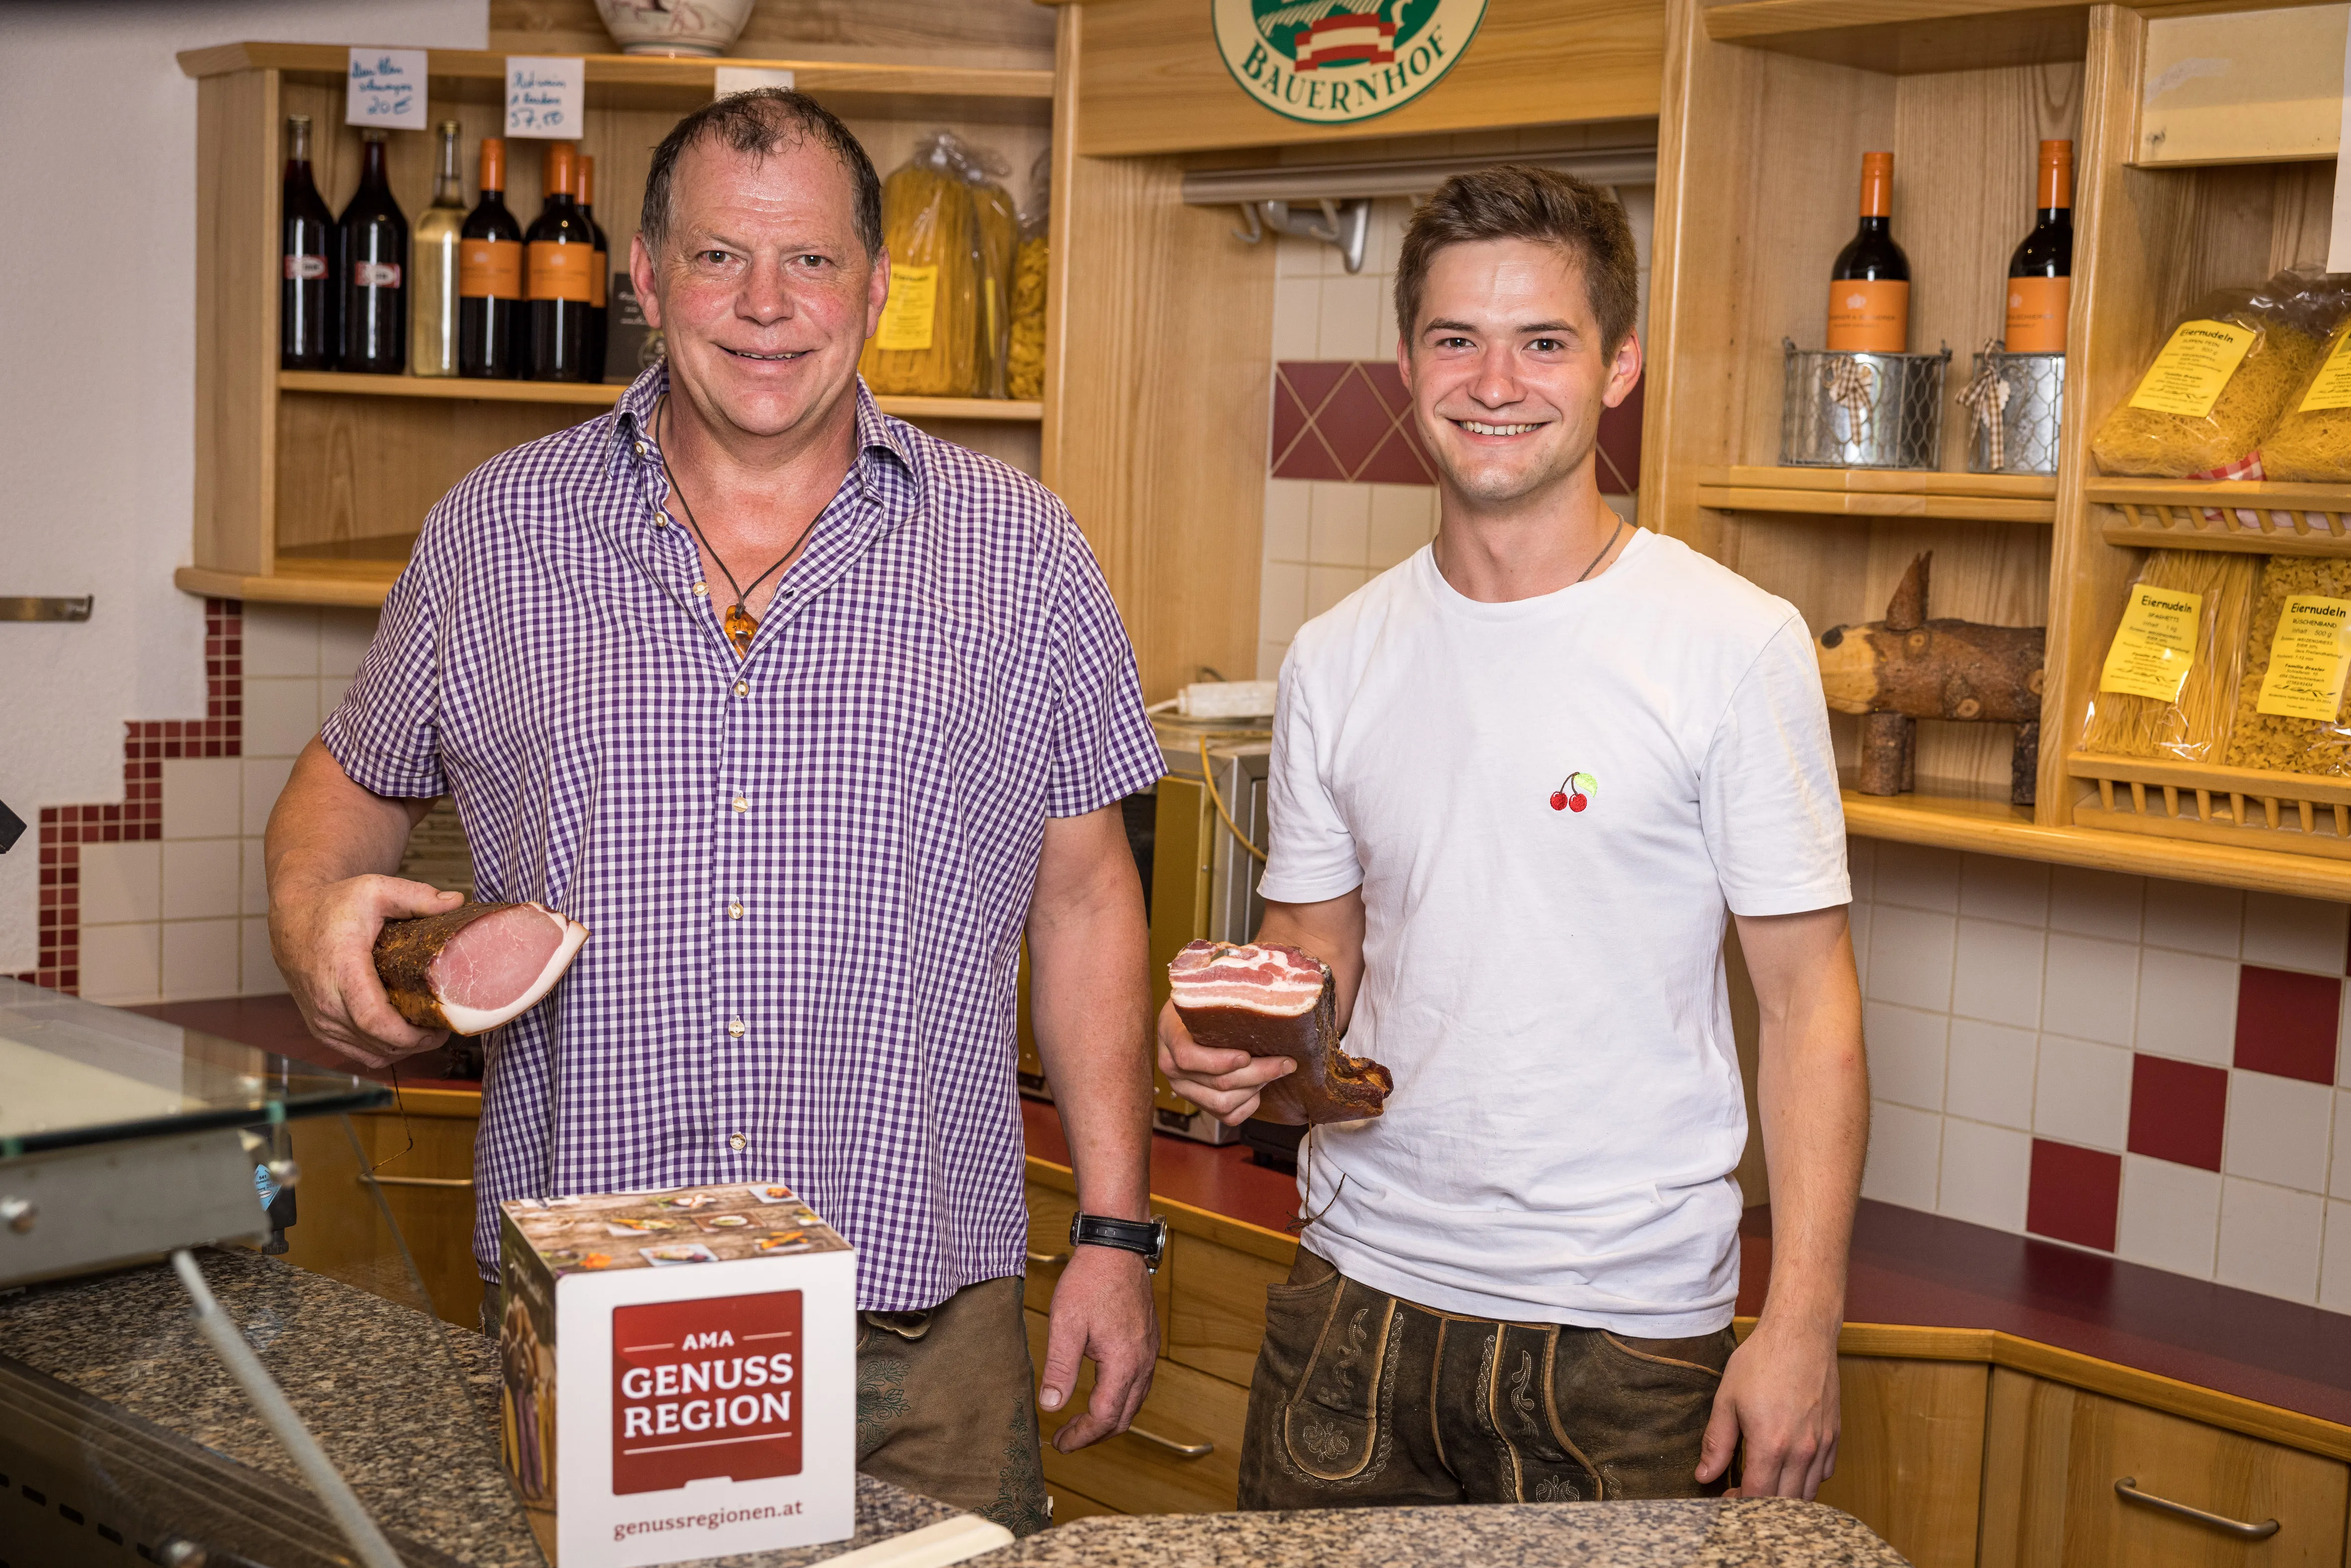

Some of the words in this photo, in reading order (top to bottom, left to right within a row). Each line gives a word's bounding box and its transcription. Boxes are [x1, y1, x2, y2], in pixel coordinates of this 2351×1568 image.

[1241, 24, 1447, 113] BAUERNHOF
[2179, 328, 2234, 344] Eiernudeln
[2141, 595, 2192, 613] Eiernudeln
[2291, 603, 2347, 618] Eiernudeln
[681, 1330, 735, 1352] AMA
[621, 1353, 794, 1399] GENUSS
[624, 1391, 792, 1439] REGION
[614, 1501, 803, 1542] genussregionen.at
